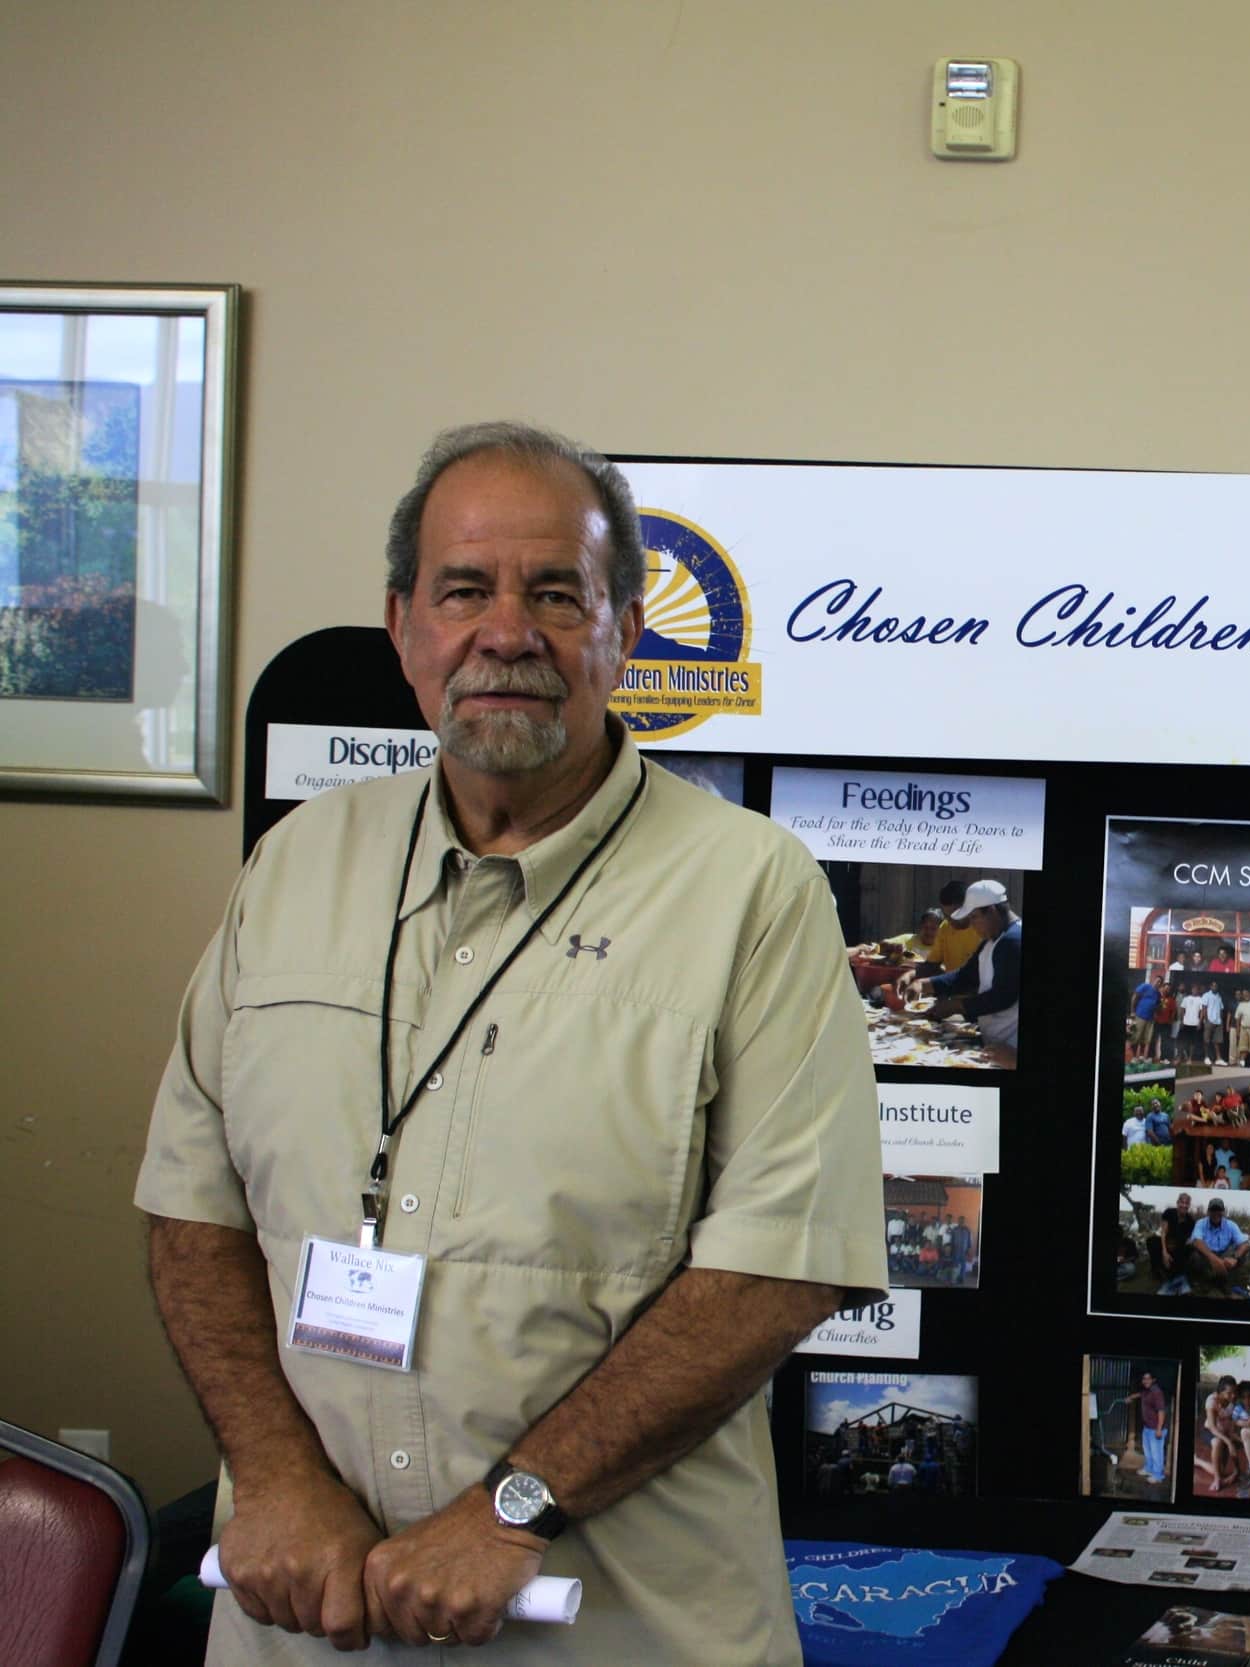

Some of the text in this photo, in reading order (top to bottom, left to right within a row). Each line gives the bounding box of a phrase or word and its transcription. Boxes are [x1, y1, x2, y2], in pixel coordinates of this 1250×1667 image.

[786, 579, 989, 645] Chosen
[668, 665, 749, 692] Ministries
[842, 782, 971, 820] Feedings
[791, 816, 1024, 837] Food for the Body Opens Doors to
[827, 834, 983, 856] Share the Bread of Life
[1173, 863, 1231, 886] CCM
[880, 1102, 972, 1124] Institute
[330, 1251, 373, 1269] Wallace
[306, 1290, 405, 1317] Chosen Children Ministries
[817, 1329, 878, 1344] Churches
[810, 1372, 907, 1386] Church Planting
[792, 1572, 1018, 1602] CARAGUA
